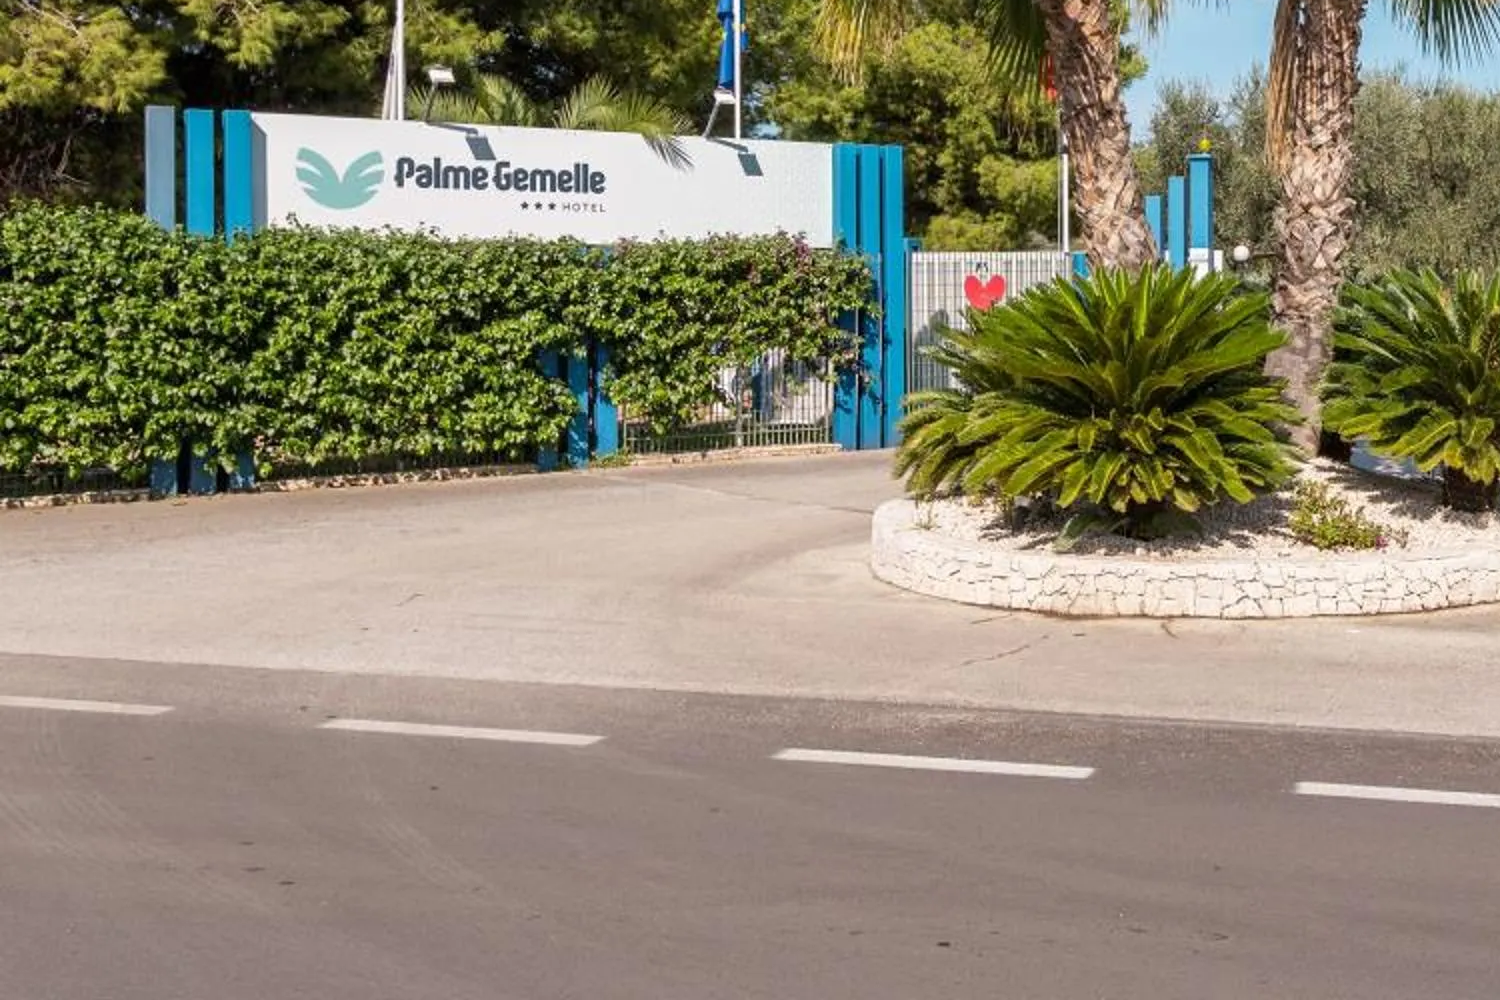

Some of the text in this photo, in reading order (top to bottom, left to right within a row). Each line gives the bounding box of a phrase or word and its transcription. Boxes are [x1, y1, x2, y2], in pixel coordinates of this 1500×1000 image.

[394, 156, 606, 194] Palme Gemelle
[562, 203, 606, 212] HOTEL
